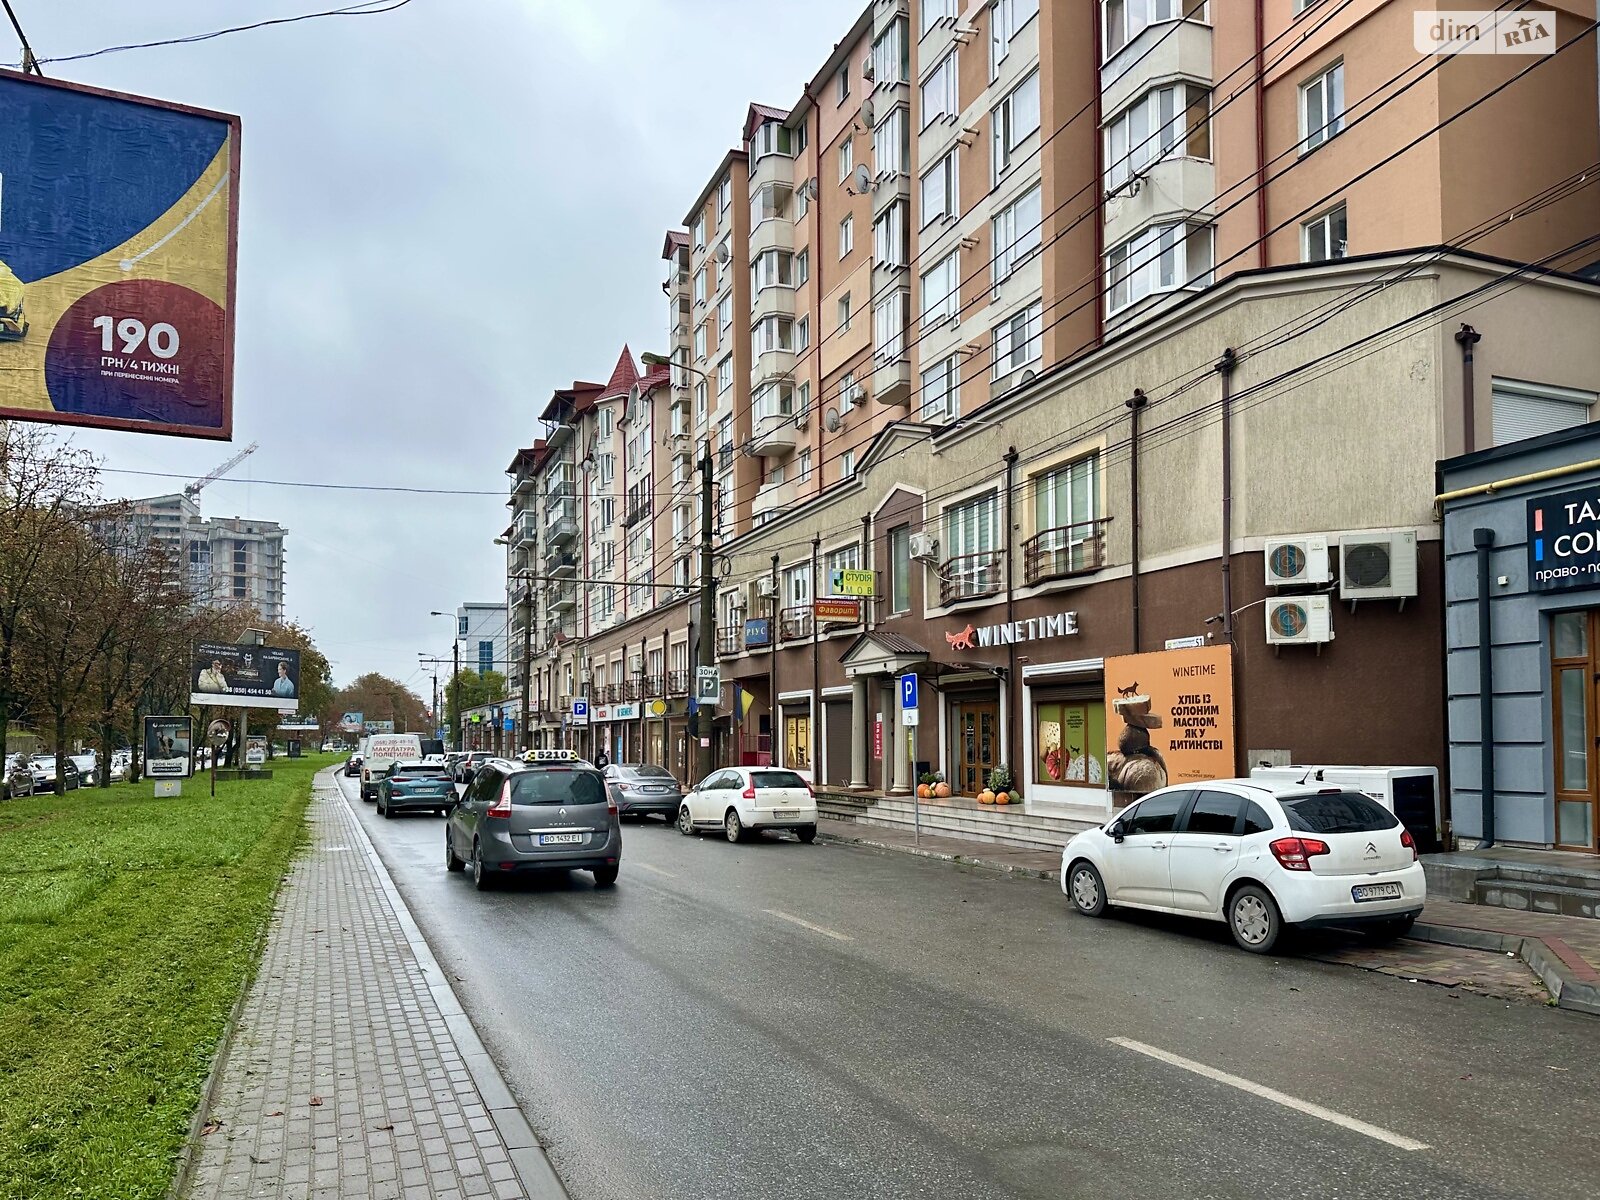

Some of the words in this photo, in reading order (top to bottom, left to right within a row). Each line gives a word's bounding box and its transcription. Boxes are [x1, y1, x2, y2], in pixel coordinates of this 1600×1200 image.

[94, 316, 180, 358] 190
[101, 356, 138, 370] ГРН/4
[140, 360, 179, 374] ТИЖНІ
[114, 372, 153, 380] ПЕРЕНЕСЕННІ
[154, 376, 180, 384] НОМЕРА
[1554, 530, 1600, 556] CO
[818, 606, 854, 615] Фаворит
[976, 611, 1078, 648] WINETIME
[1172, 664, 1216, 677] WINETIME
[906, 681, 912, 702] P
[1178, 695, 1200, 705] ХЛІБ
[1203, 694, 1211, 704] ІЗ
[577, 703, 584, 713] P
[1171, 705, 1219, 716] СОЛОНИМ
[1173, 717, 1218, 728] МАСЛОМ,
[1185, 729, 1198, 738] ЯК
[1199, 729, 1206, 738] У
[1170, 740, 1222, 751] ДИТИНСТВІ
[1357, 888, 1368, 897] BO
[1369, 886, 1385, 896] 9779
[1386, 885, 1396, 894] CA
